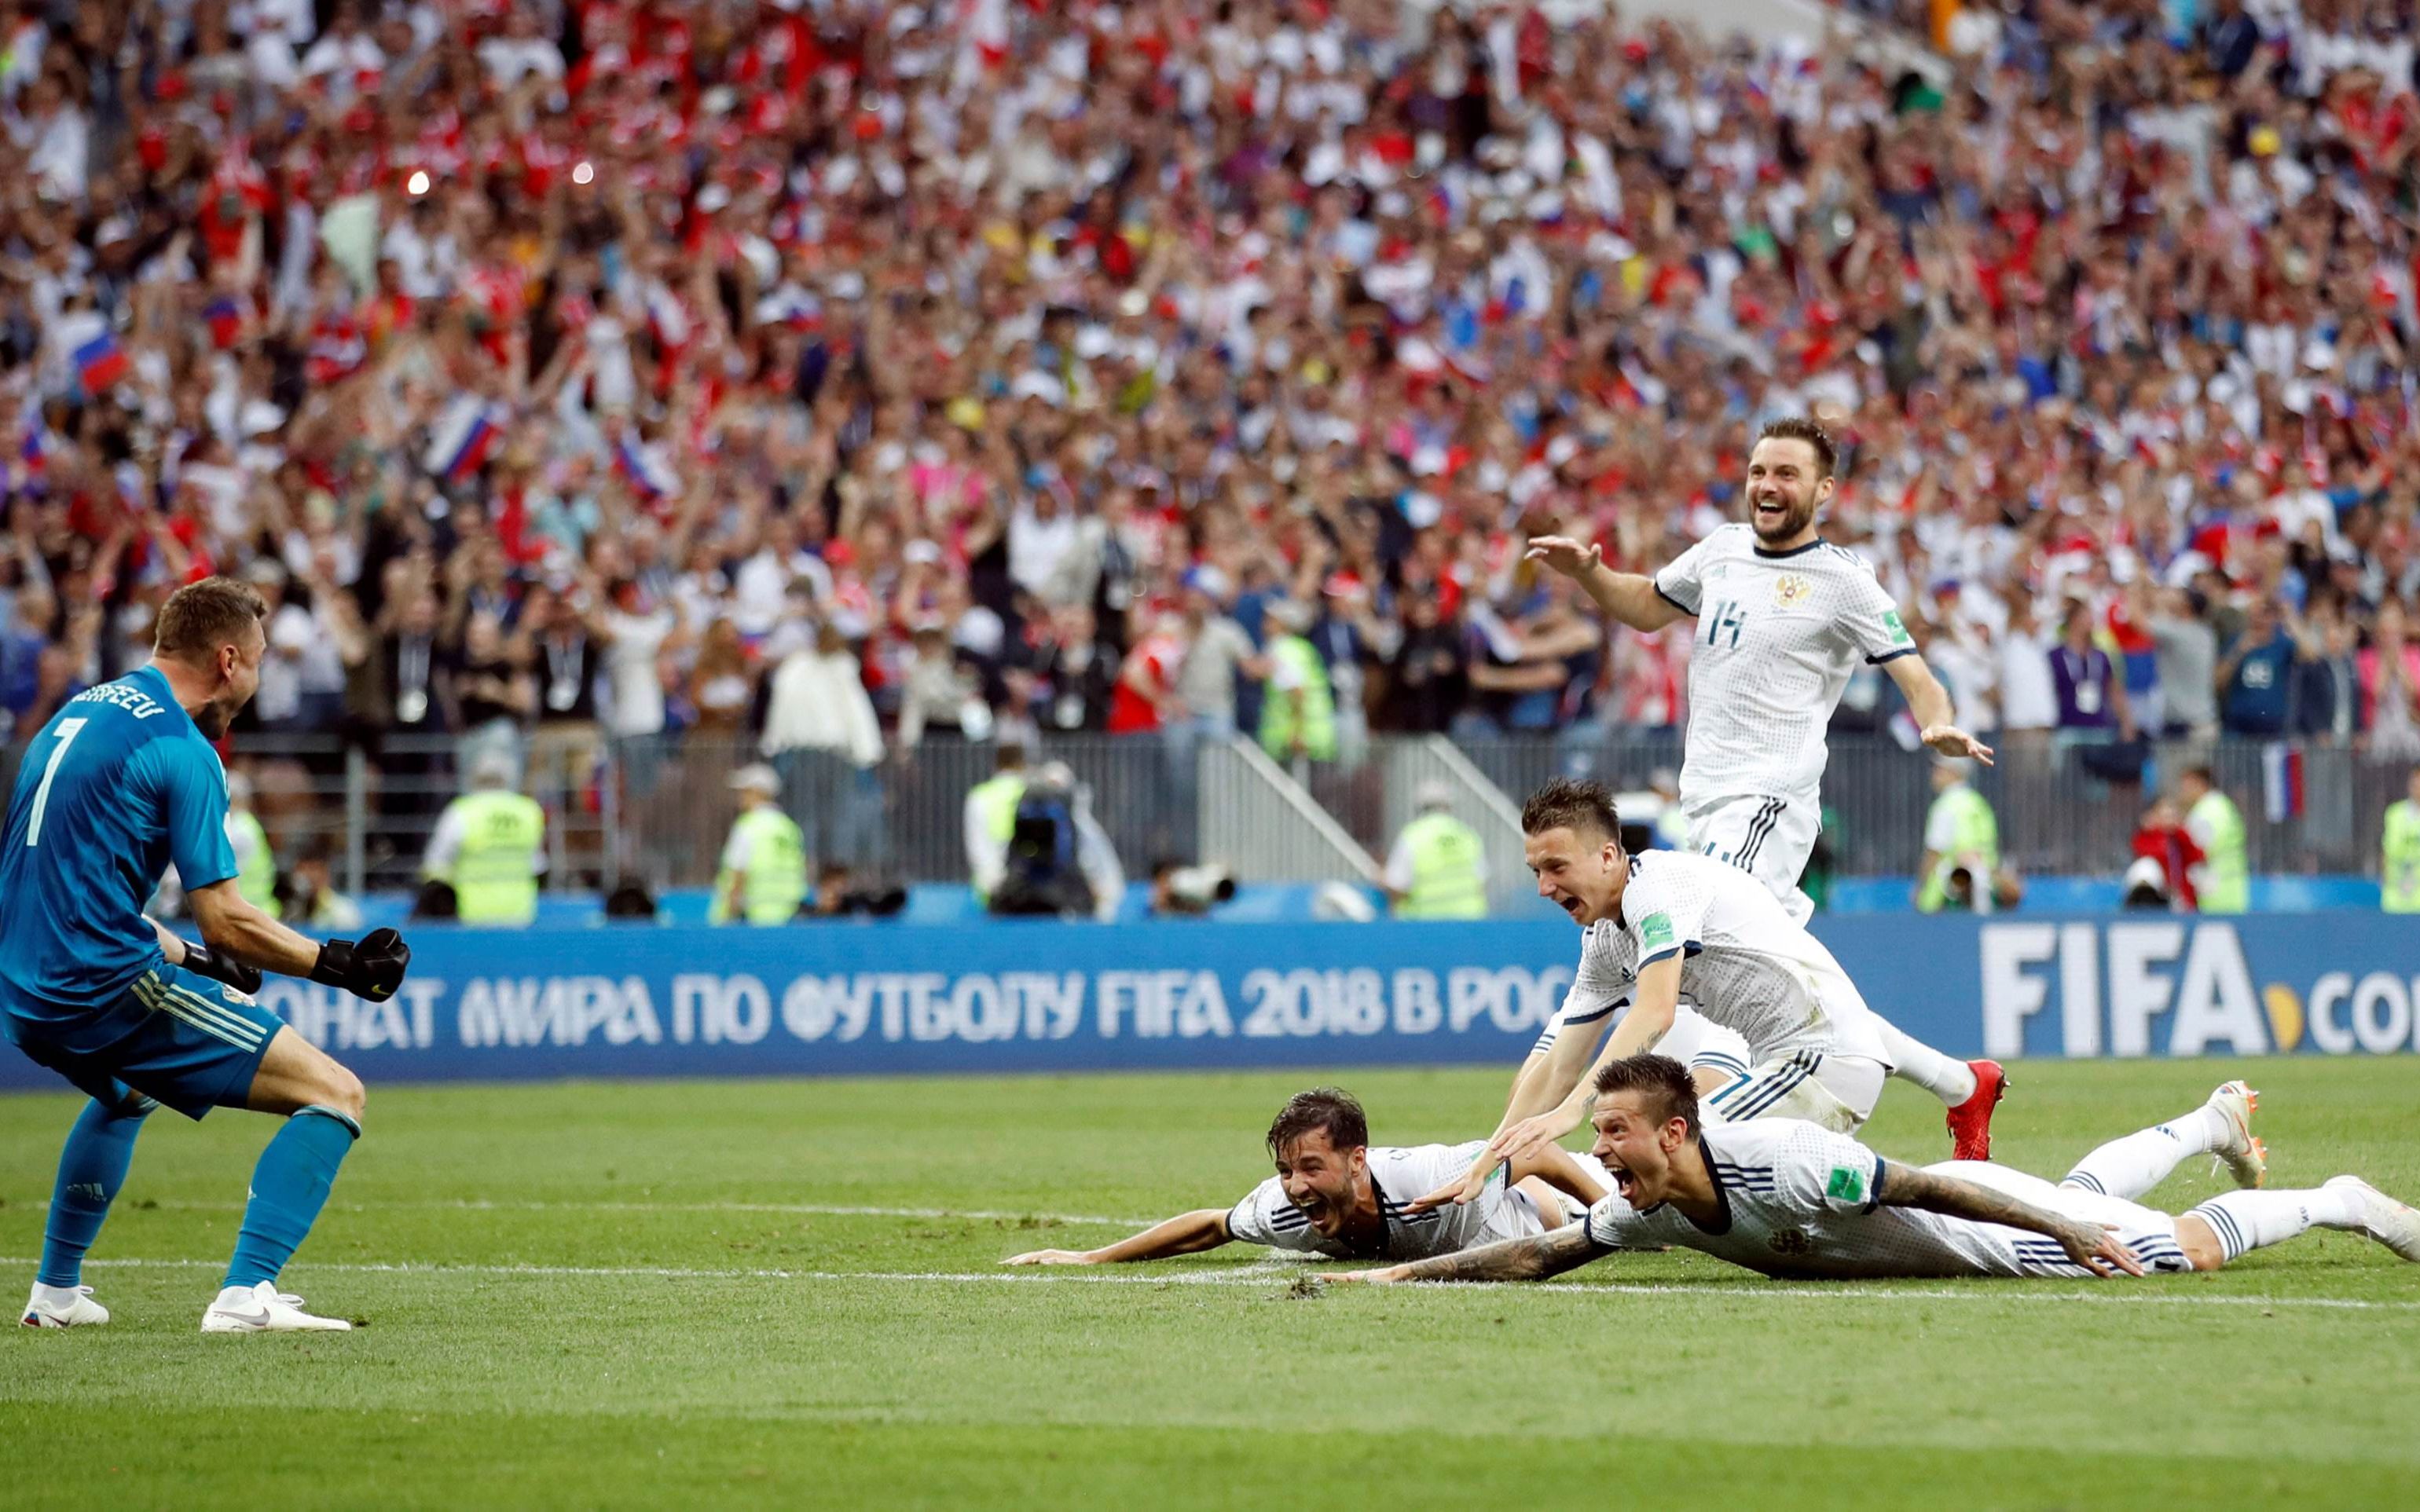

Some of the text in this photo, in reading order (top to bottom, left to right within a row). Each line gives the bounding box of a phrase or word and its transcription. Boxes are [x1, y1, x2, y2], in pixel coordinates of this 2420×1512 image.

[1708, 599, 1746, 650] 14
[26, 717, 88, 847] 1
[458, 976, 662, 1048] МИРА
[672, 974, 771, 1044] ПО
[782, 972, 1085, 1042] ФУТБОЛУ
[1097, 968, 1234, 1038] FIFA
[1241, 967, 1386, 1036] 2018
[1392, 966, 1443, 1034] В
[1978, 921, 2420, 1056] FIFA.co
